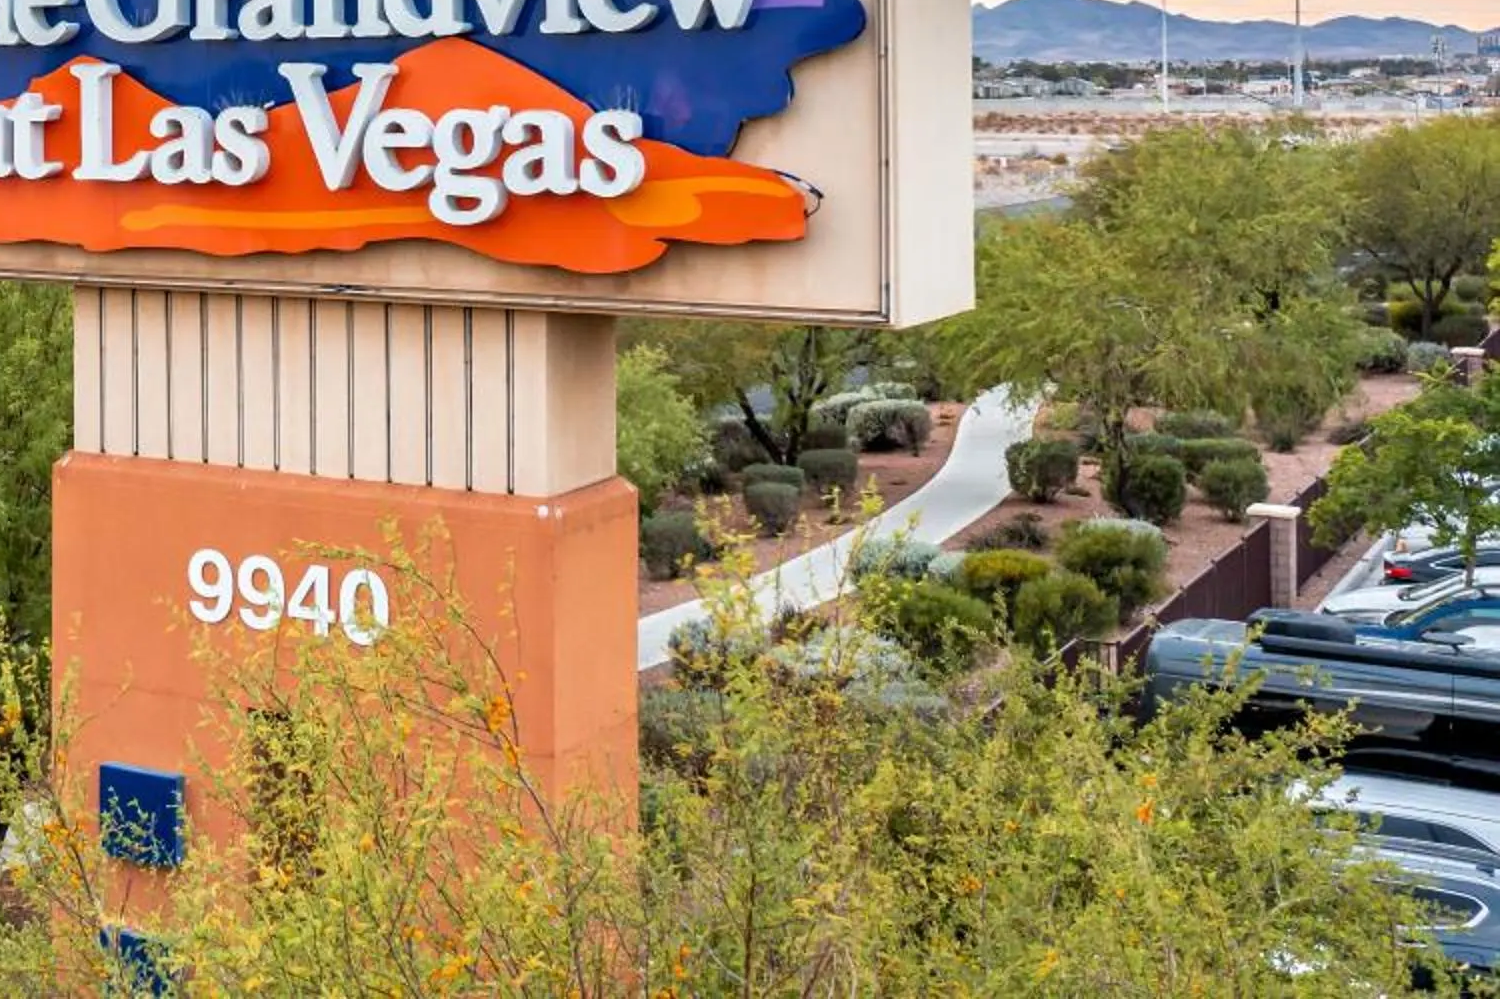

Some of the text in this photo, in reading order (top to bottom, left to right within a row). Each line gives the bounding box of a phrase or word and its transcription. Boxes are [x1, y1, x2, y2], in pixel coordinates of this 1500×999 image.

[70, 62, 271, 186] Las
[278, 62, 646, 226] Vegas
[188, 549, 389, 646] 9940
